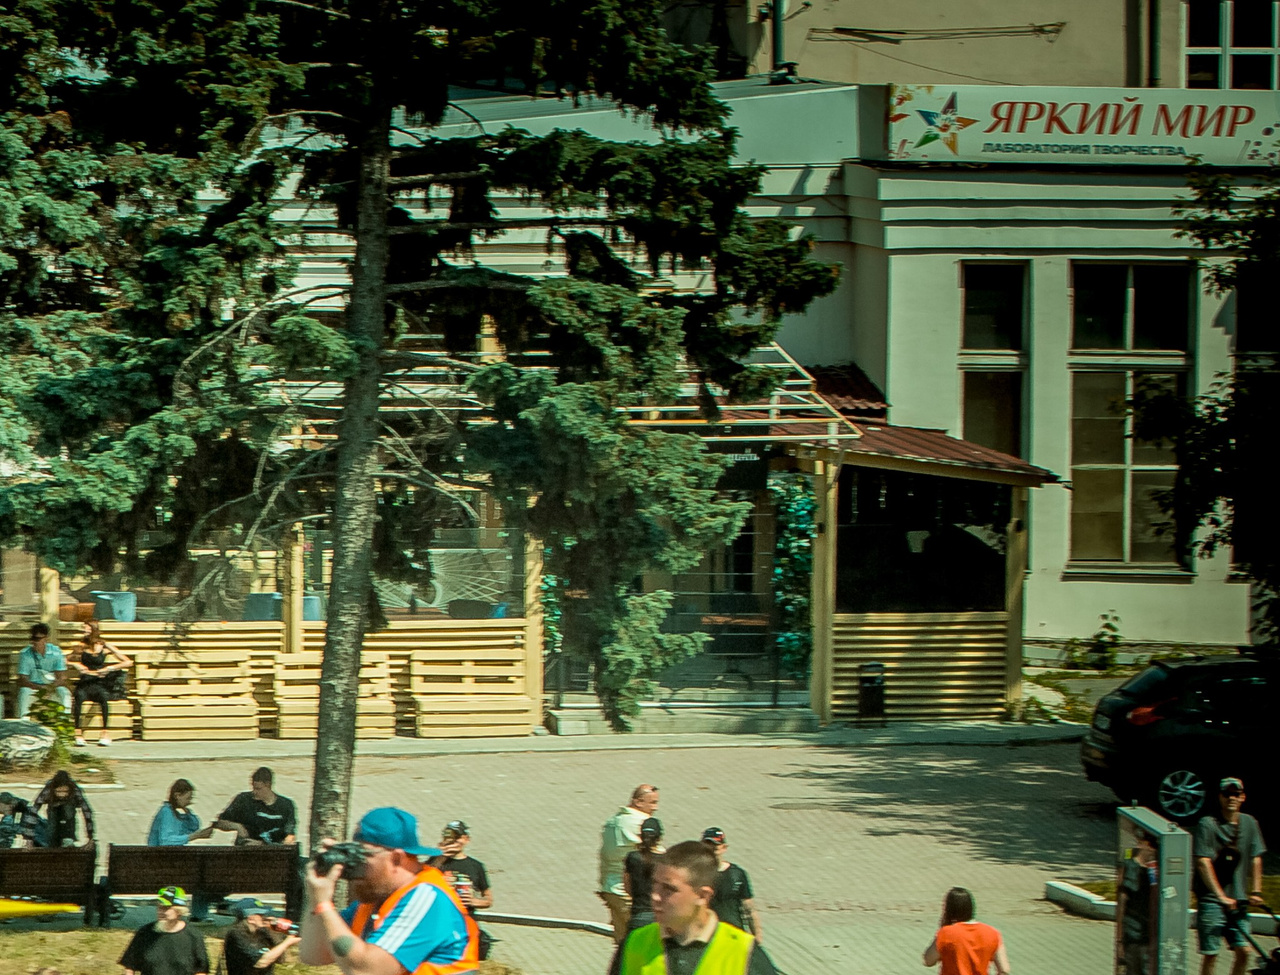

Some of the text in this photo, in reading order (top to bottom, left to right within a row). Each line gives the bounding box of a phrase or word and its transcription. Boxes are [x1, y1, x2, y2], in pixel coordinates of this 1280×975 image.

[983, 96, 1256, 138] ЯРКИЙ МИР
[982, 141, 1186, 156] ЛАБОРАТОРИЯ ТВОРЧЕСТВА
